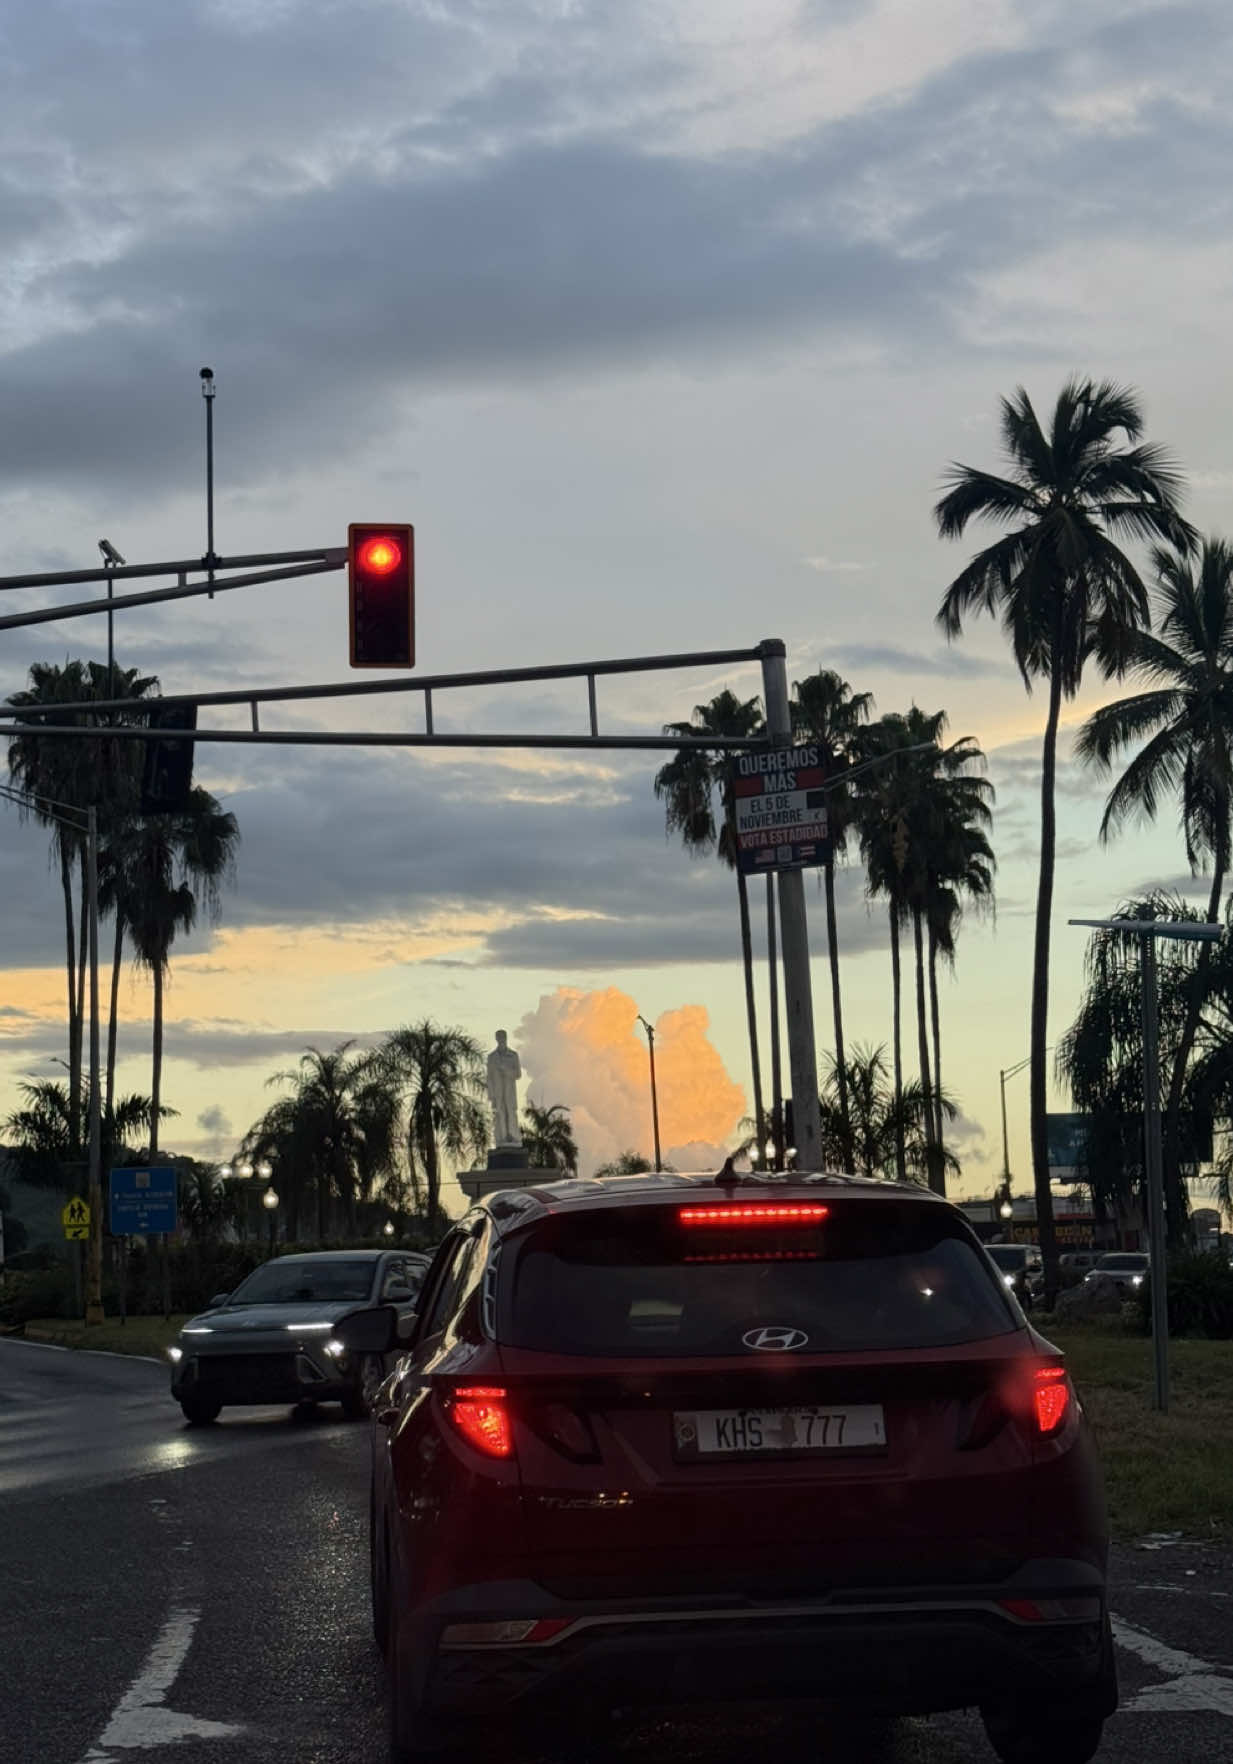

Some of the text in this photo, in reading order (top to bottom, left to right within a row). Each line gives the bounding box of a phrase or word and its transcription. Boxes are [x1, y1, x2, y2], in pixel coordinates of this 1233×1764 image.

[739, 747, 818, 775] QUEREMOS
[751, 798, 763, 813] EL
[775, 795, 791, 809] DE
[740, 809, 803, 830] NOVIEMBRE
[740, 824, 827, 849] VOTA ESTADIDAD
[715, 1415, 847, 1449] KHS 777
